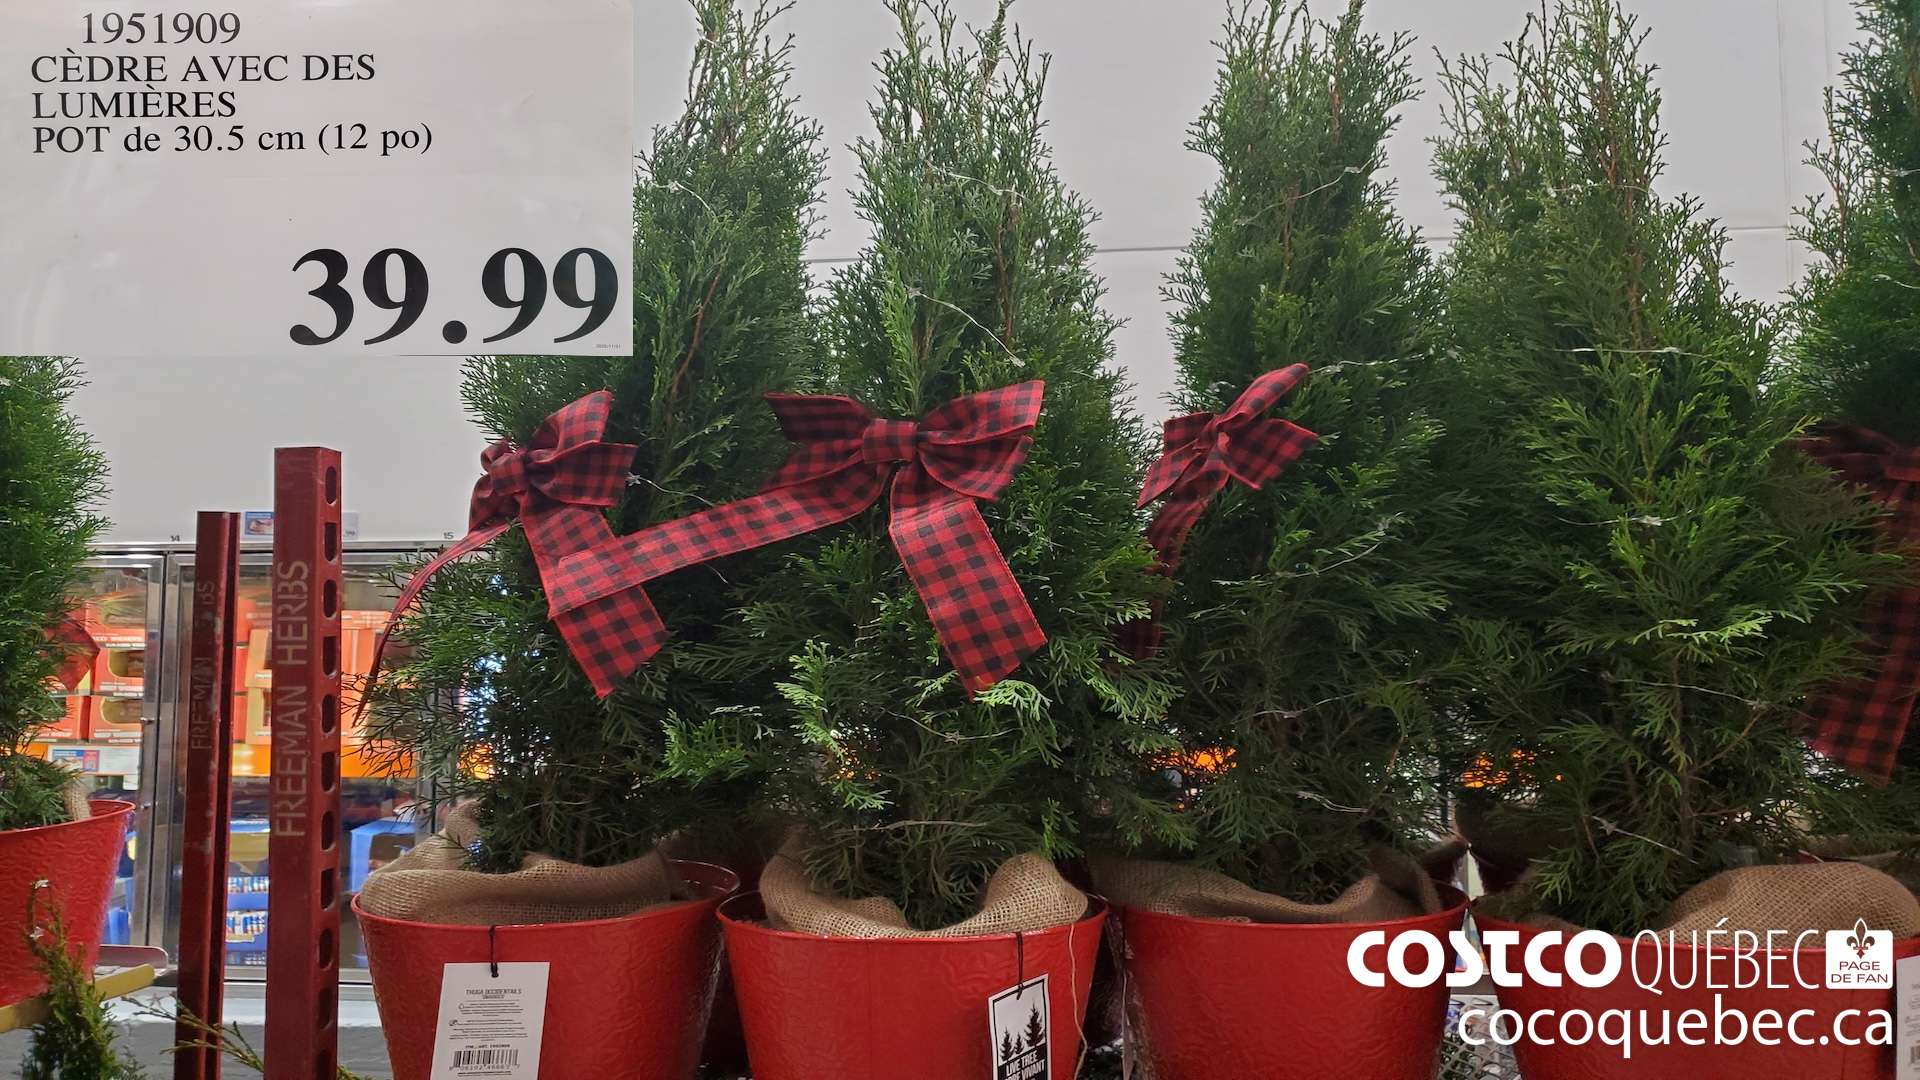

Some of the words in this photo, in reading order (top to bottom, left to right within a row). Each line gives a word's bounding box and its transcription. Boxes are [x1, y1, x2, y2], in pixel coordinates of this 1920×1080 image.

[83, 13, 241, 44] 1951909
[32, 47, 168, 83] CÈDRE
[181, 55, 290, 82] AVEC
[303, 54, 375, 81] DES
[32, 84, 236, 119] LUMIÈRES
[34, 126, 111, 154] POT
[123, 125, 161, 153] de
[174, 125, 244, 152] 30.5
[258, 132, 306, 151] cm
[318, 123, 368, 156] (12
[380, 122, 432, 157] po)
[290, 248, 619, 346] 39.99
[277, 560, 309, 666] HERBS
[275, 685, 308, 837] FREEMAN
[1006, 1059, 1021, 1076] LIVE
[1020, 1050, 1039, 1069] TREE
[1020, 1059, 1045, 1080] VIVANT
